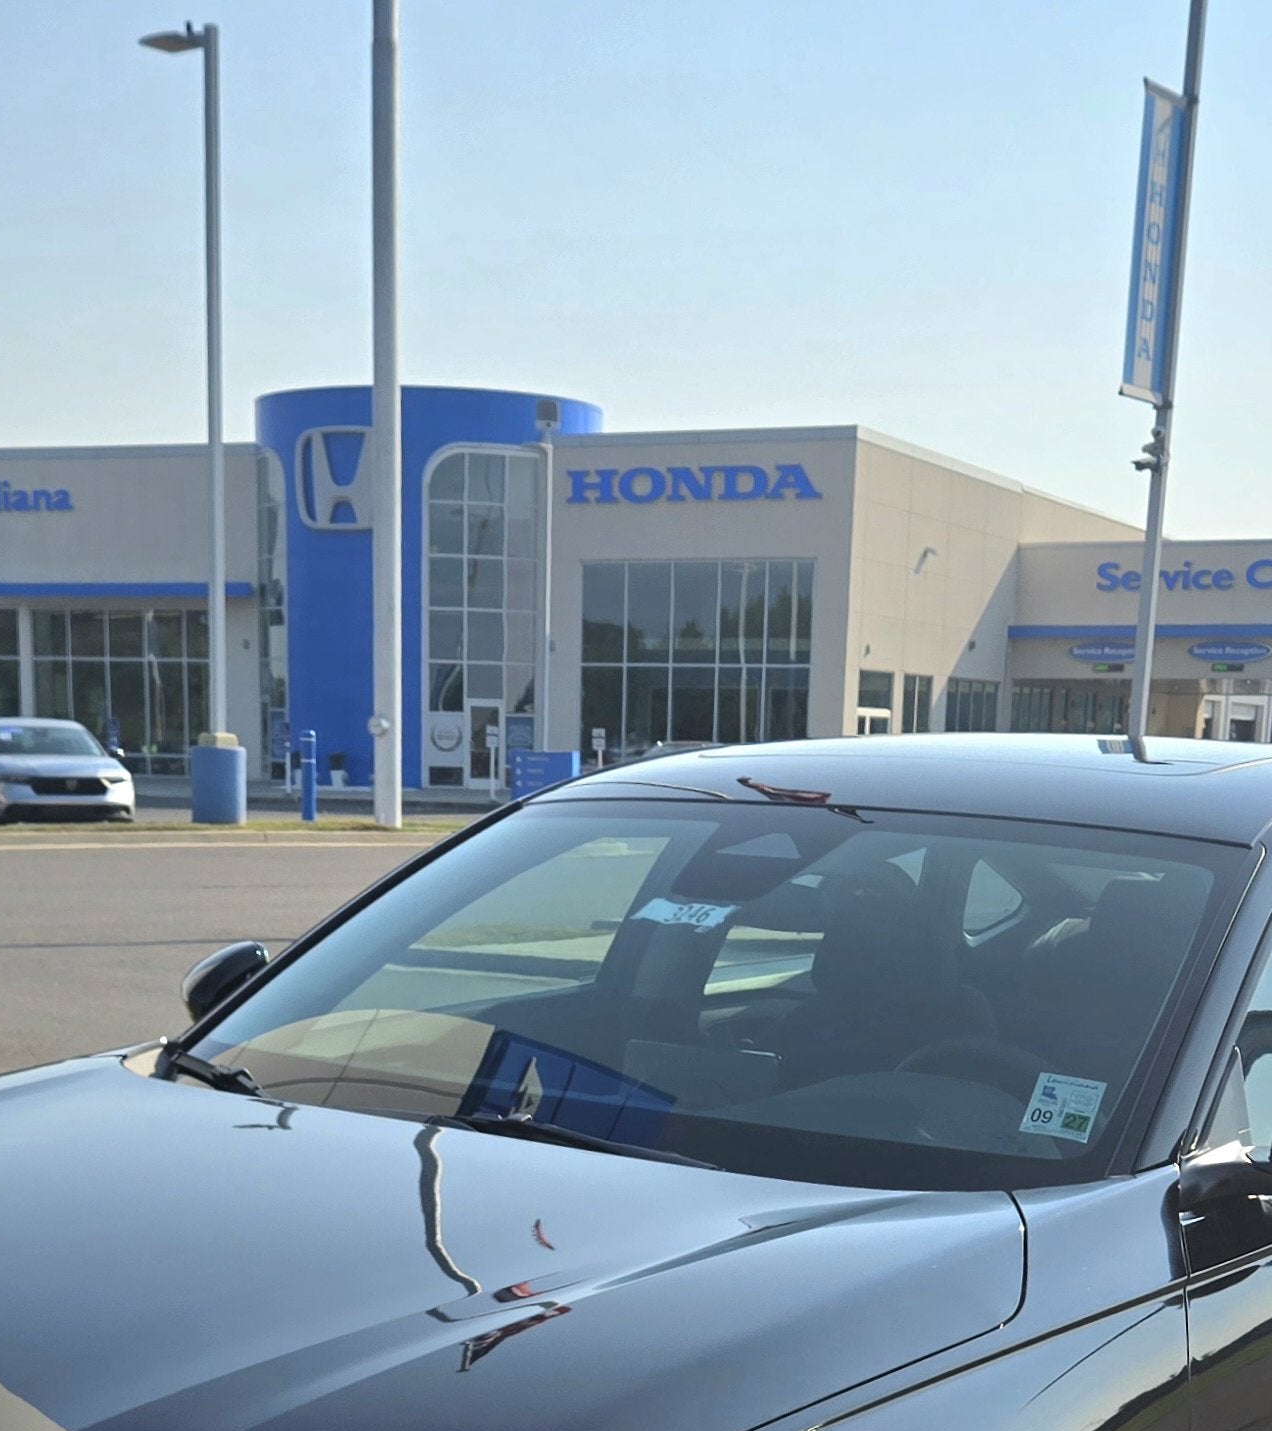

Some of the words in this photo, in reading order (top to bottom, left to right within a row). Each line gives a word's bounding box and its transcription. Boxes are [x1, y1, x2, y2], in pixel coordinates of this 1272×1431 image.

[1137, 184, 1165, 360] HONDA
[566, 463, 823, 505] HONDA
[1096, 560, 1235, 592] Sevice
[1030, 1107, 1054, 1124] 09
[1063, 1112, 1090, 1131] 27
